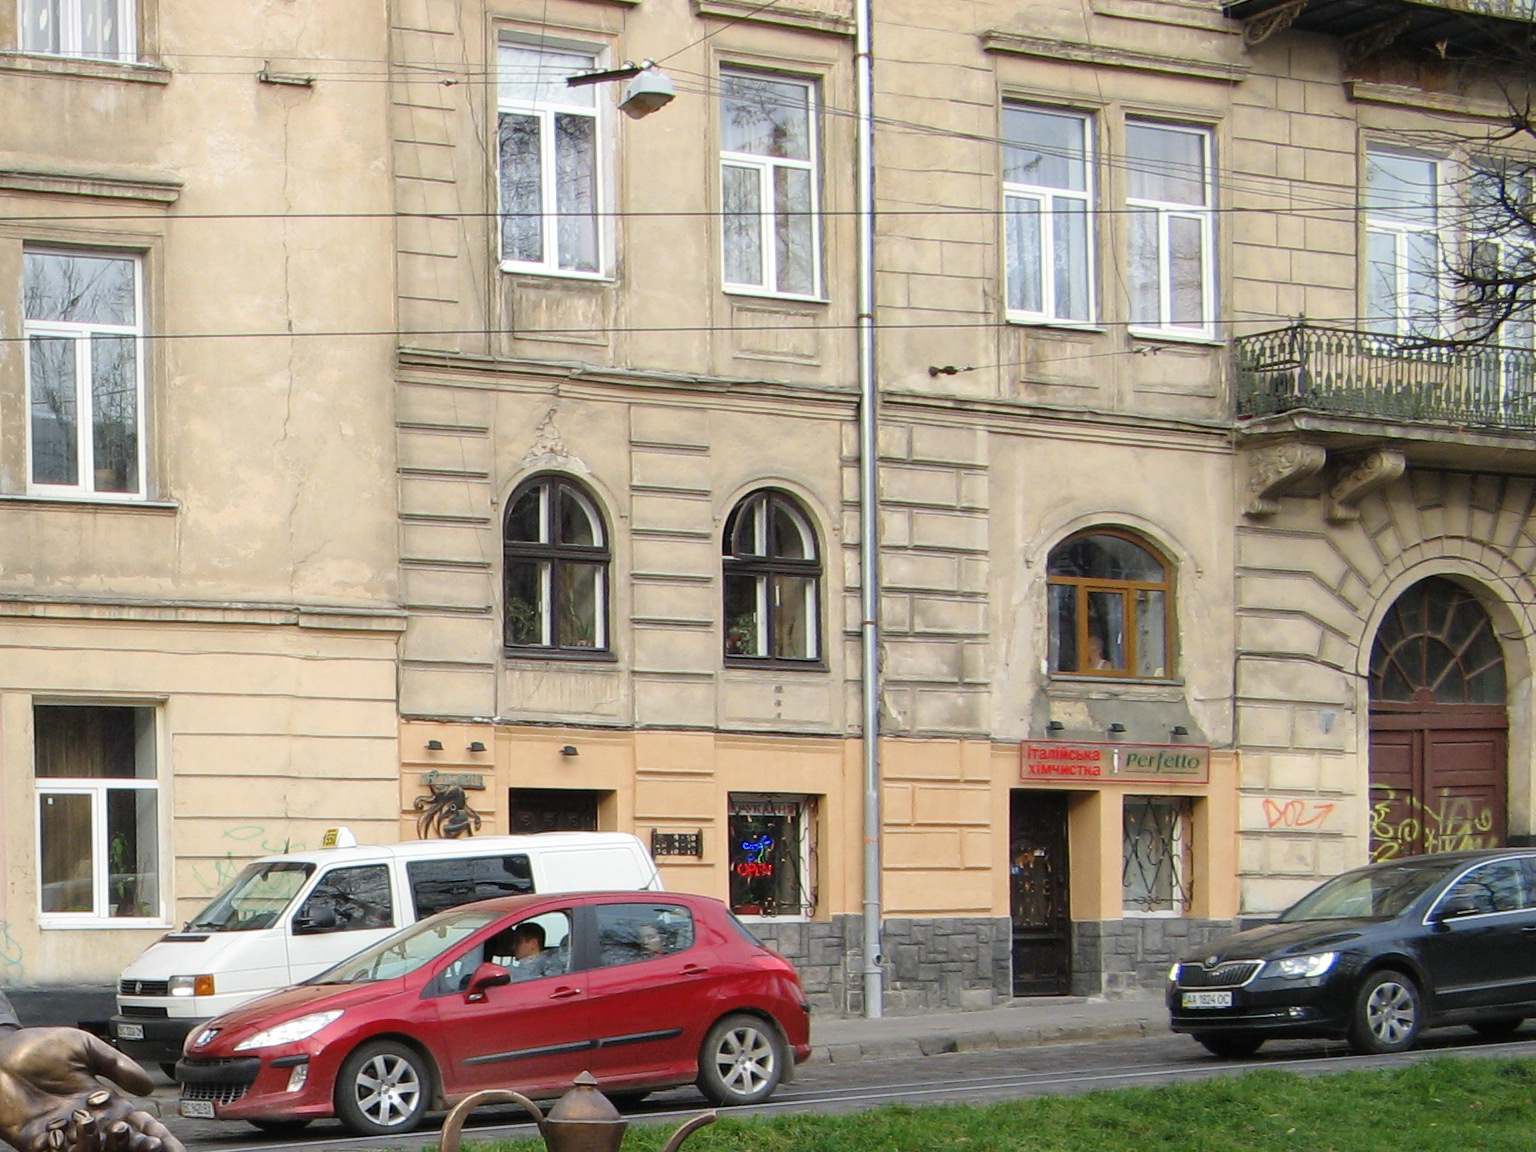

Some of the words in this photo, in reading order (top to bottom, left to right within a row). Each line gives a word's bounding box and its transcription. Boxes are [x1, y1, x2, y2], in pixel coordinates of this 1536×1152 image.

[1125, 750, 1200, 773] Perfetto
[1028, 763, 1101, 776] хімчистка
[737, 862, 774, 877] OPEN
